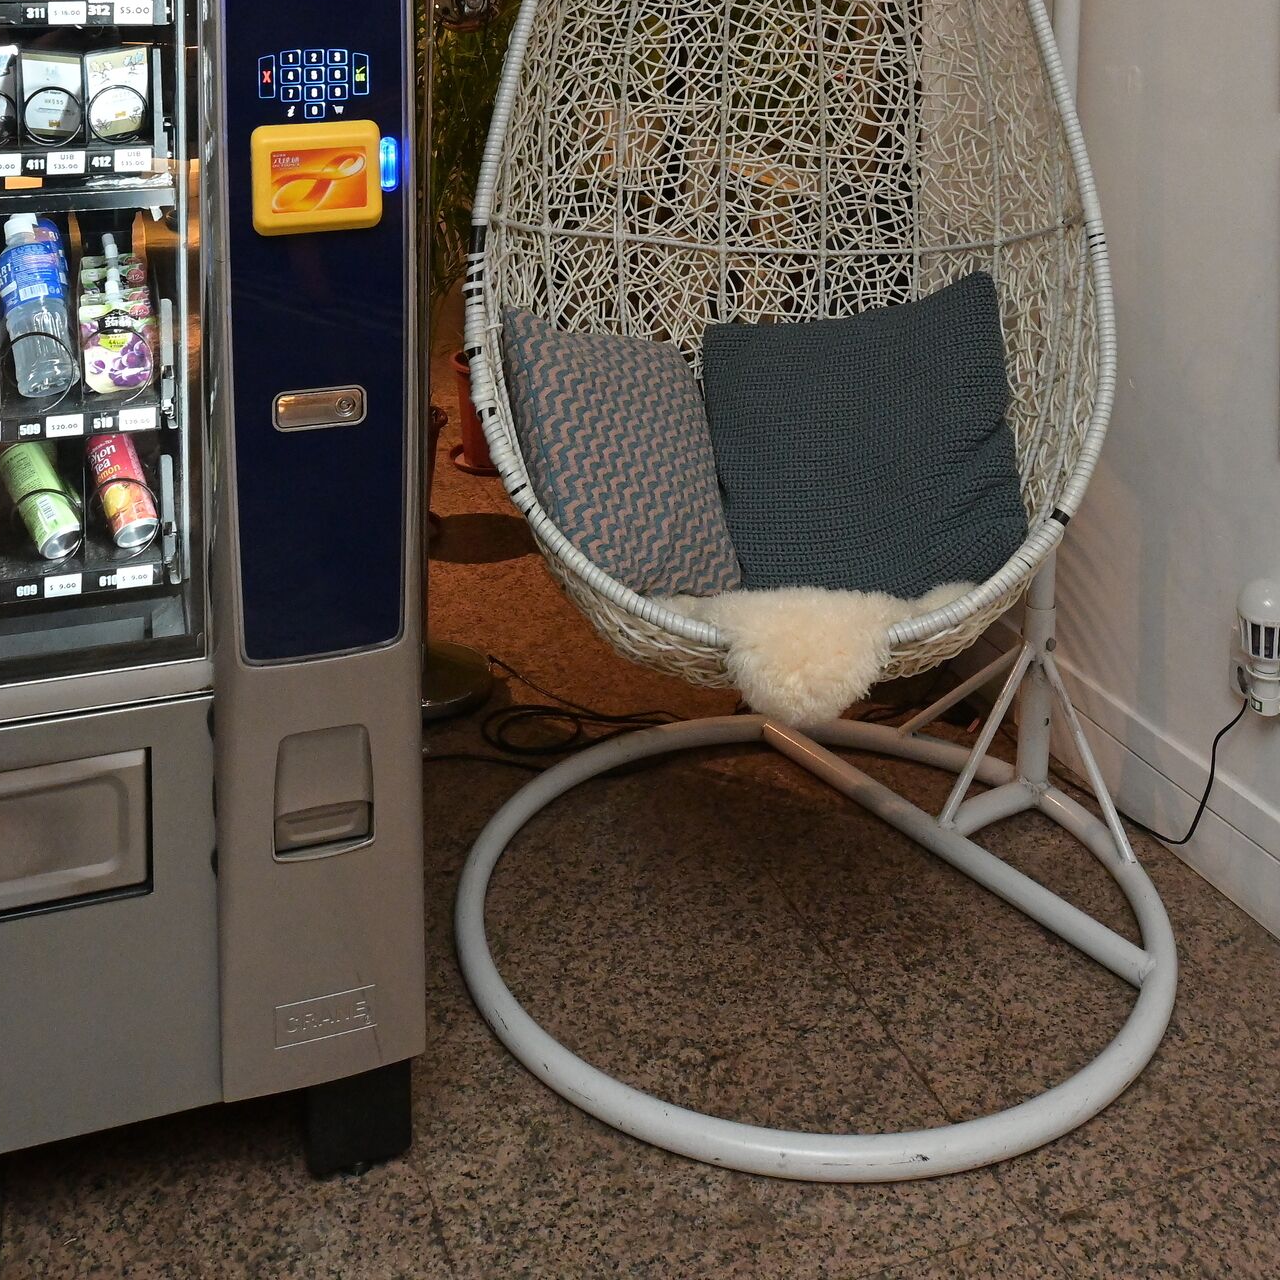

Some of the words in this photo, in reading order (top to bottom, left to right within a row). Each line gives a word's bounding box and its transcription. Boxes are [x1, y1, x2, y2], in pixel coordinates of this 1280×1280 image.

[26, 7, 46, 20] 311
[87, 5, 111, 16] 312
[288, 53, 293, 63] 1
[311, 52, 317, 62] 2
[334, 52, 340, 62] 3
[287, 70, 293, 80] 4
[311, 70, 317, 80] 5
[334, 69, 341, 80] 6
[355, 73, 366, 82] OK
[288, 89, 294, 98] 7
[311, 87, 318, 97] 8
[335, 87, 341, 97] 9
[311, 105, 318, 115] 0
[26, 159, 45, 170] 411
[91, 156, 112, 167] 412
[19, 423, 41, 436] 509
[16, 585, 38, 597] 609
